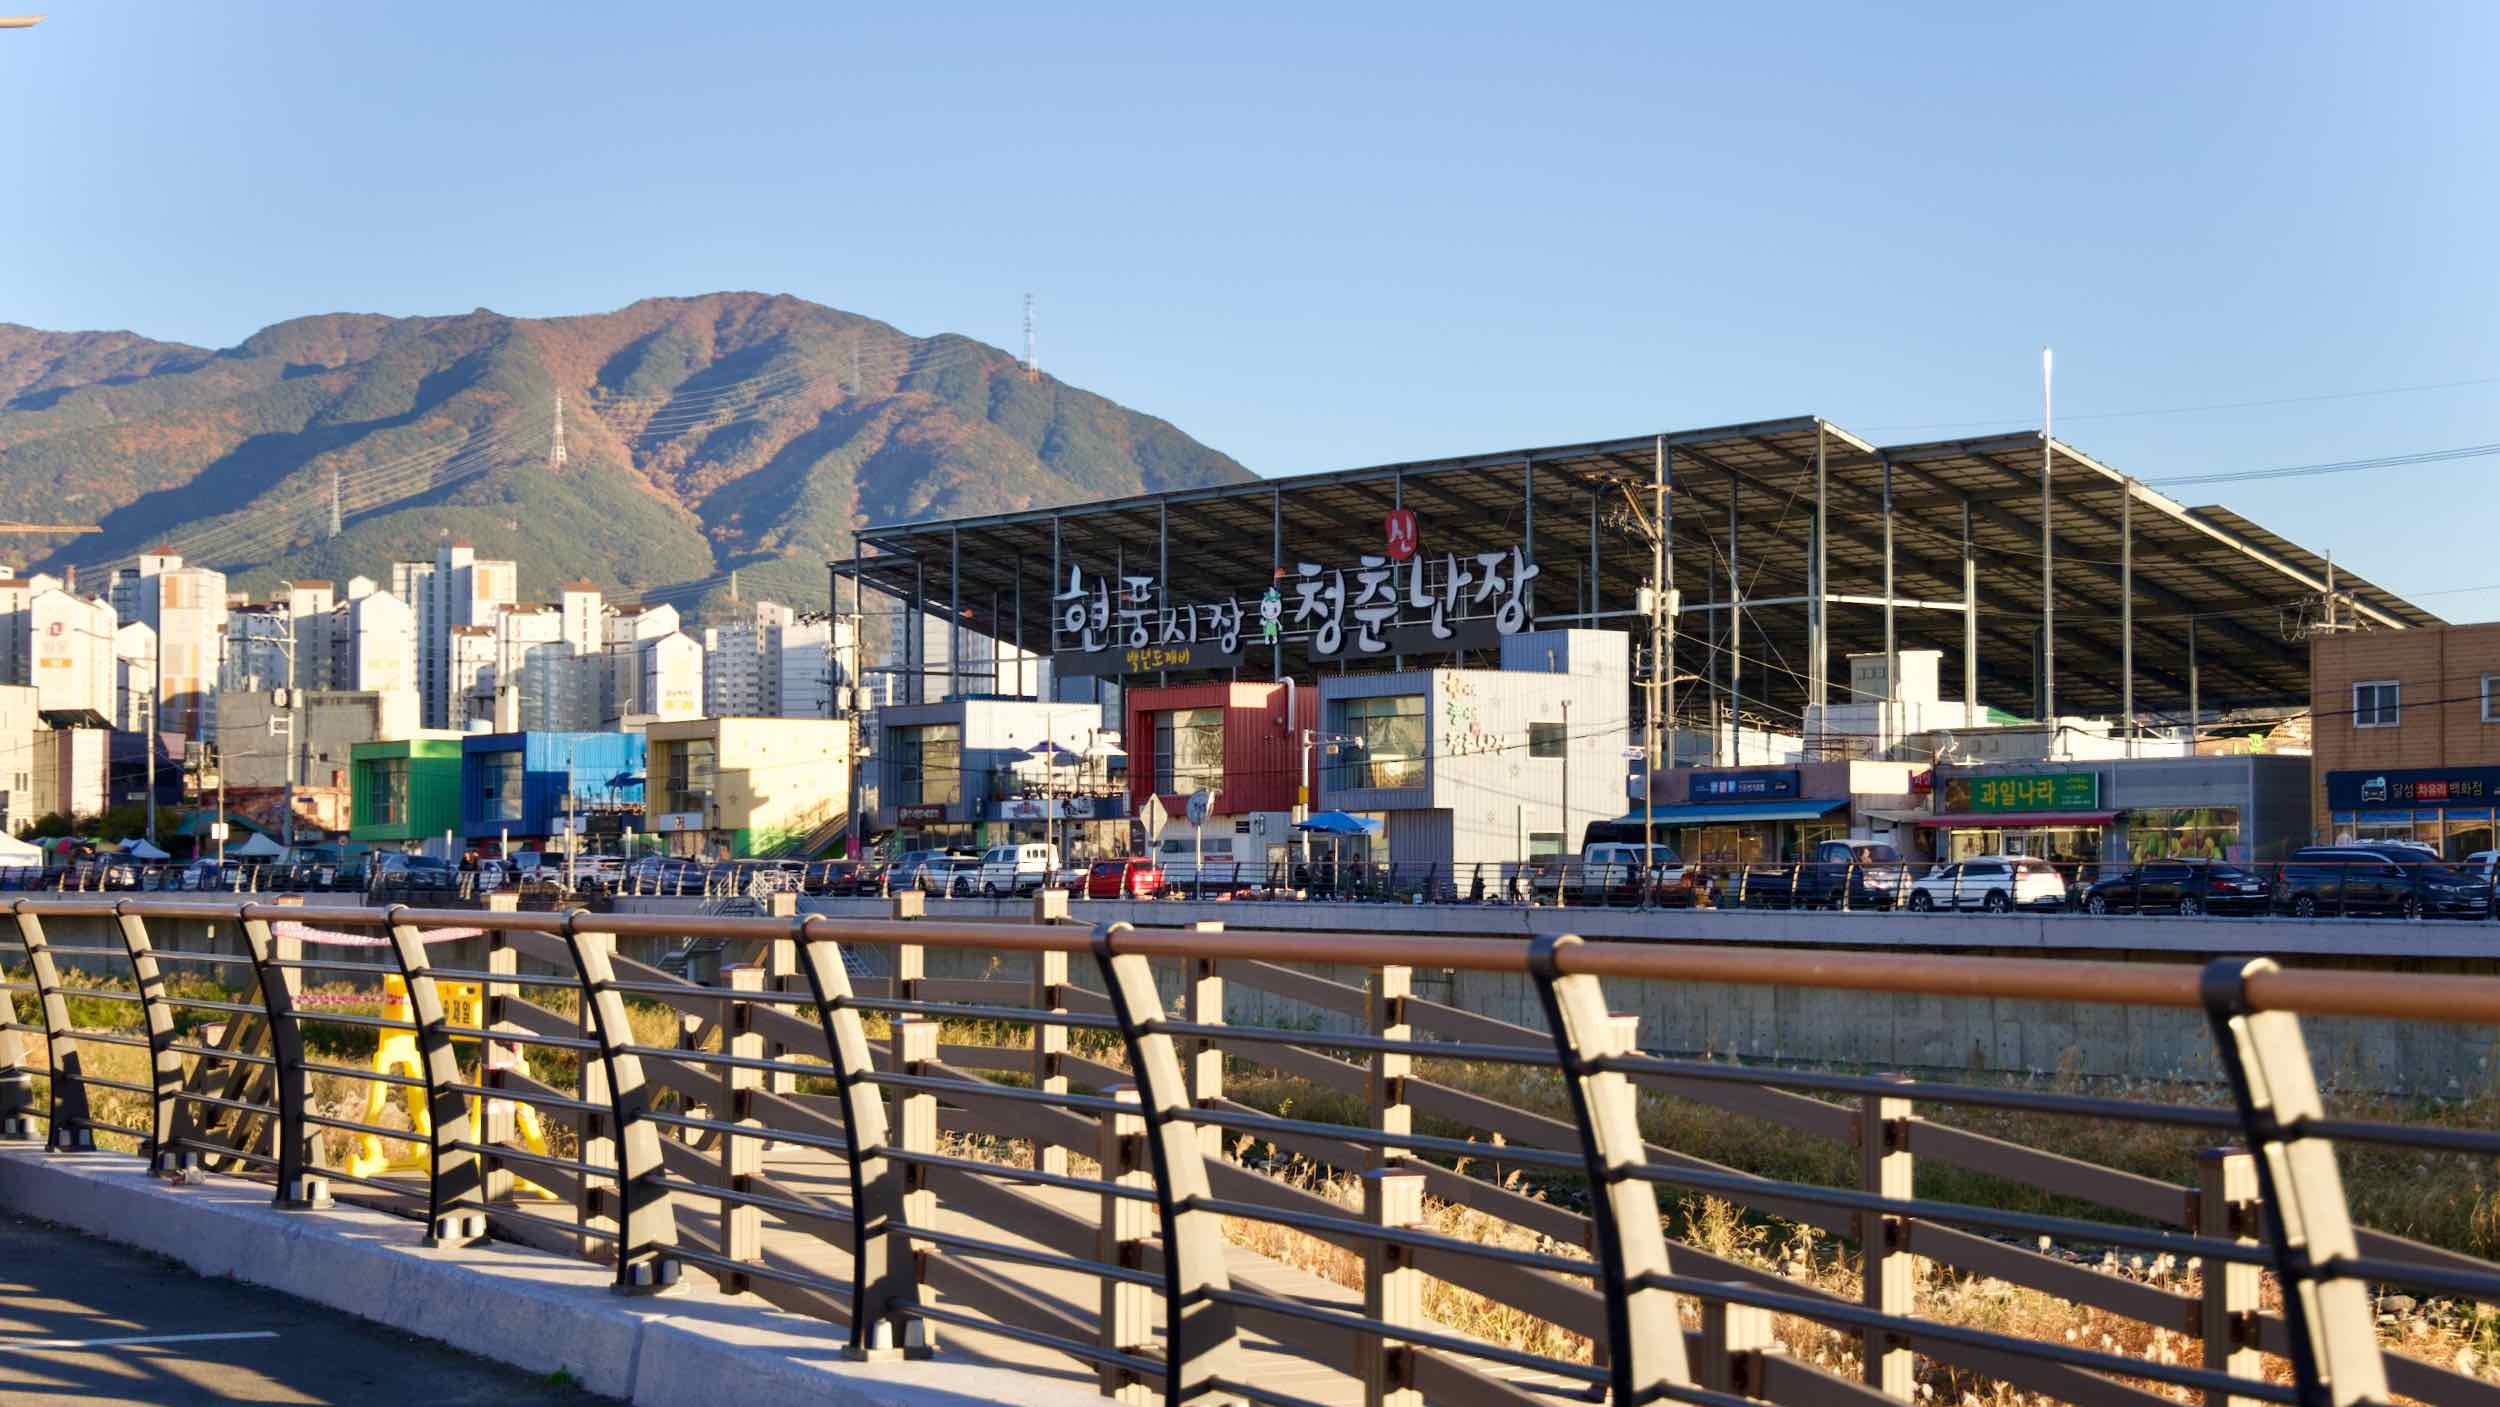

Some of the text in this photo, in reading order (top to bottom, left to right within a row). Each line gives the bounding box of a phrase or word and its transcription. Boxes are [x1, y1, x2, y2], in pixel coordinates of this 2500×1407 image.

[1054, 545, 1540, 654] 현풍시장 청춘난장
[1980, 779, 2056, 807] 과일나라
[2392, 783, 2414, 799] 달성
[2449, 780, 2483, 796] 백화점
